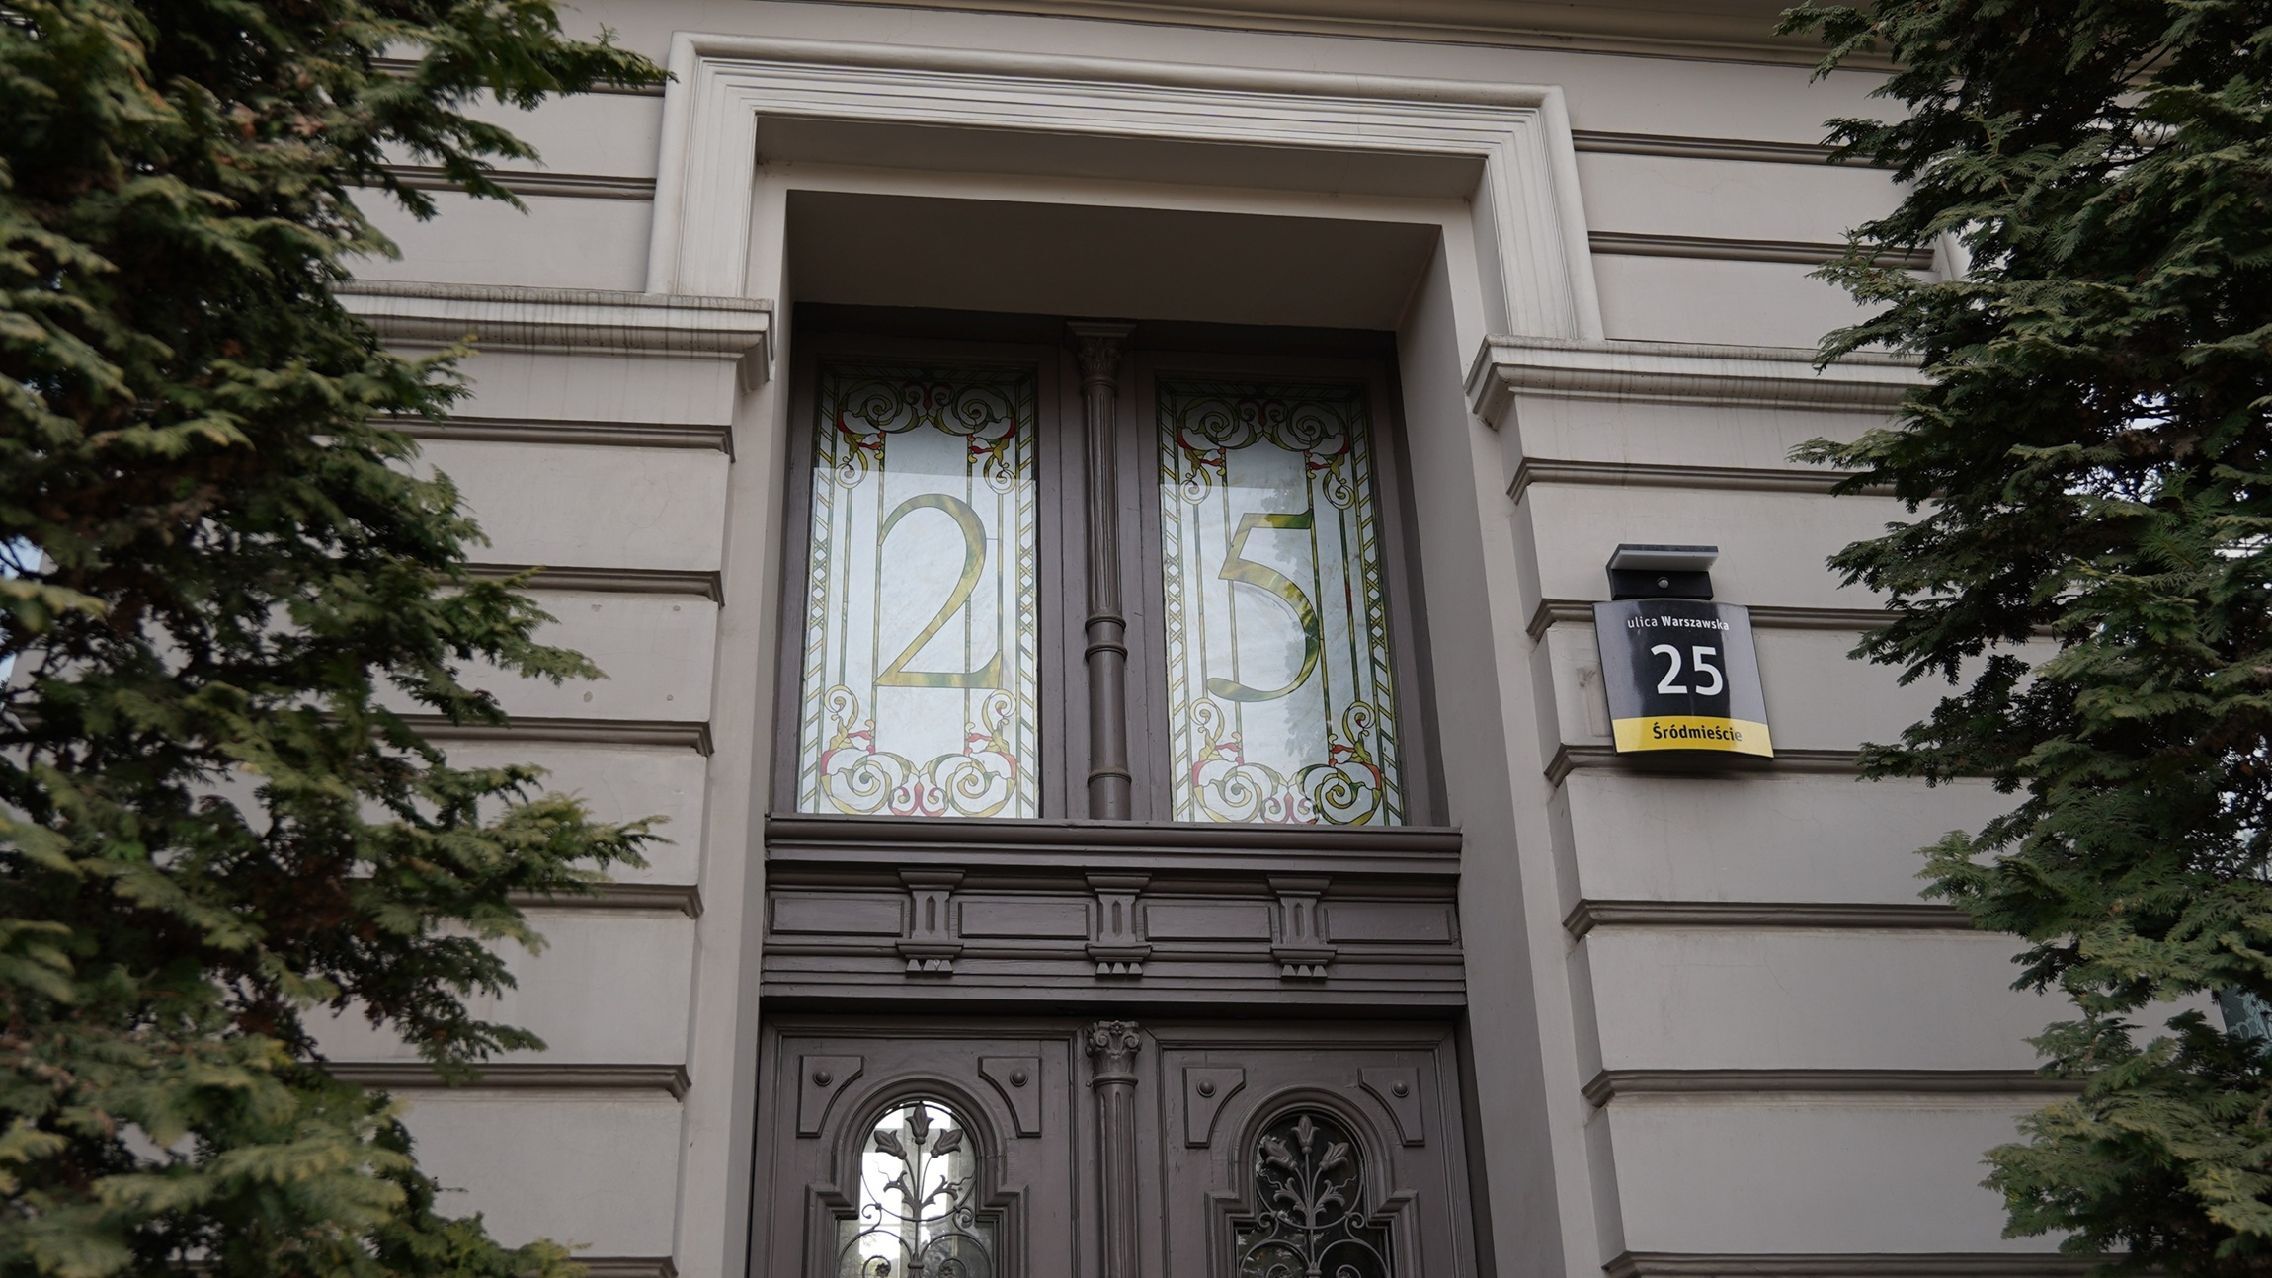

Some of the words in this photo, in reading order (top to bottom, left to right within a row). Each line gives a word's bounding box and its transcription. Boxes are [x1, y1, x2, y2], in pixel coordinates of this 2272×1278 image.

[874, 493, 1002, 689] 2
[1206, 509, 1320, 702] 5
[1627, 616, 1658, 629] ulica
[1660, 616, 1730, 631] Warszawska
[1650, 644, 1724, 696] 25
[1653, 722, 1743, 742] Śródmieście
